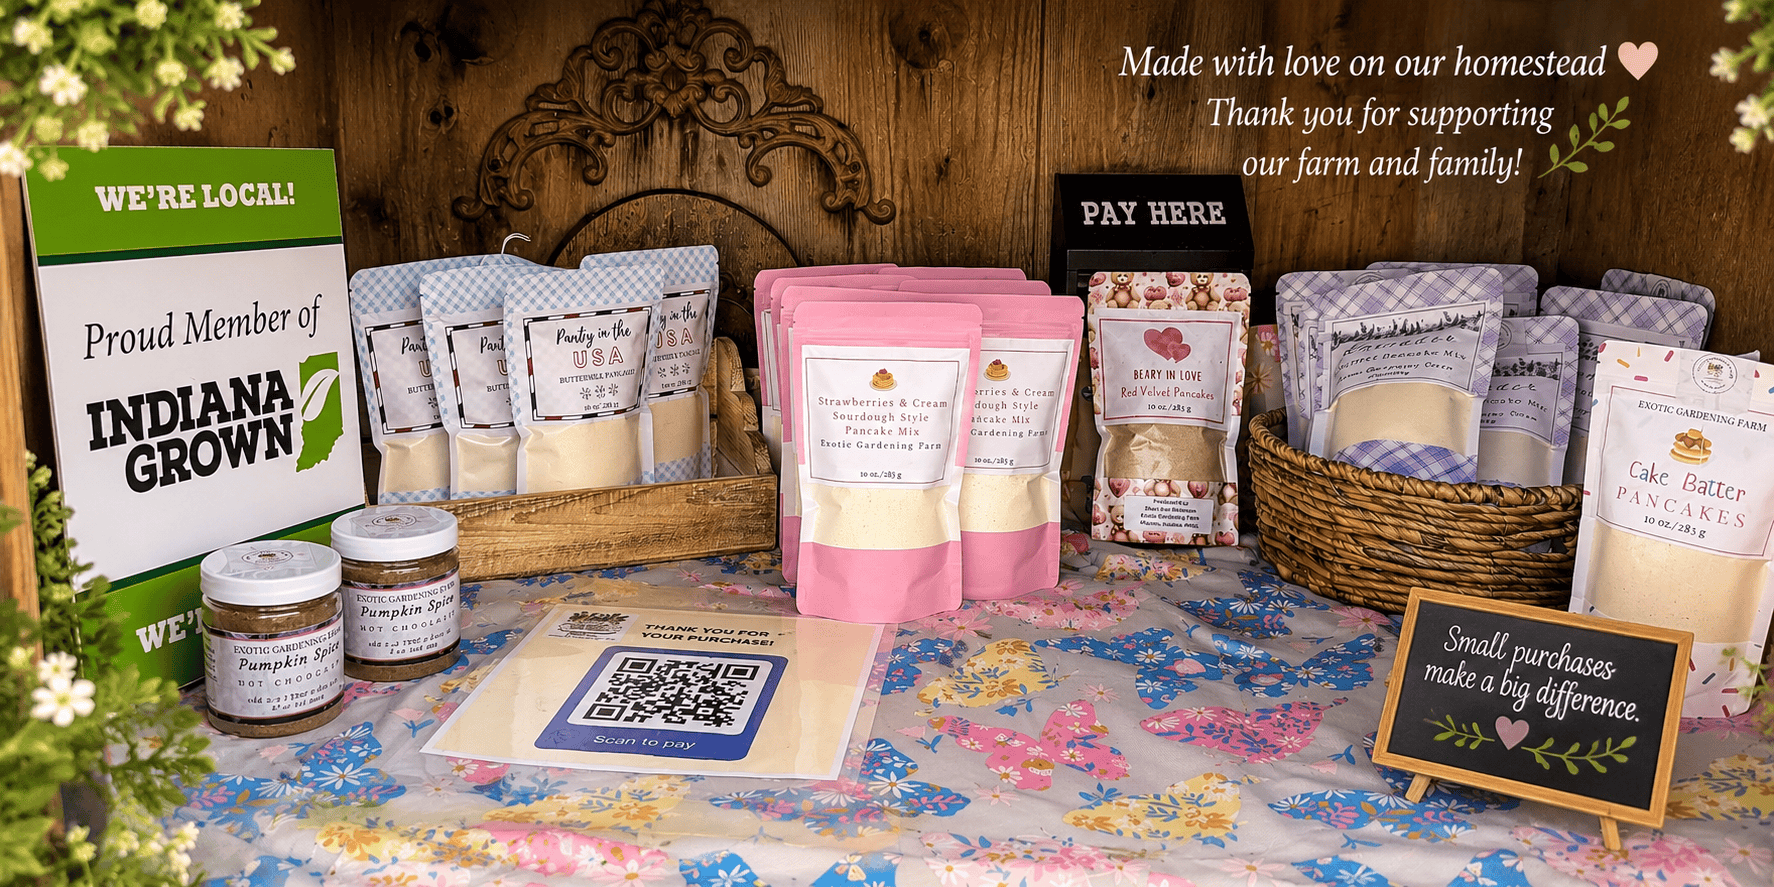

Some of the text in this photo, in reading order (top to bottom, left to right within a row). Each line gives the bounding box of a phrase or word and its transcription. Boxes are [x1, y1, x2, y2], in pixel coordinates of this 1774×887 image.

[95, 182, 295, 212] WE'RE LOCAL!
[1081, 201, 1227, 225] PAY HERE
[83, 294, 323, 361] Proud Member of
[597, 327, 610, 338] in
[611, 318, 632, 341] the
[572, 345, 624, 369] USA
[1133, 369, 1202, 381] BEARY IN LOVE
[1012, 388, 1019, 396] &
[1024, 388, 1055, 397] Cream
[1121, 386, 1138, 399] Red
[1174, 387, 1214, 400] Pancakes
[86, 369, 294, 451] INDIANA
[818, 396, 948, 408] Strawberries & Cream
[974, 400, 1039, 412] dough Style
[832, 411, 929, 424] Sourdough Style
[971, 415, 1007, 424] ancake
[1638, 400, 1767, 432] EXOTIC GARDENING FARM
[845, 426, 920, 436] Pancake Mix
[970, 428, 1024, 438] Gardening
[125, 412, 294, 493] GROWN
[820, 439, 852, 449] Exotic
[856, 441, 914, 451] Gardening
[1009, 458, 1014, 466] g
[1629, 461, 1746, 502] Cake Batter
[1616, 486, 1746, 528] PANCAKES
[1644, 515, 1656, 524] 10
[1698, 529, 1707, 539] g
[357, 588, 438, 603] EXOTIC GARDENING
[360, 604, 422, 621] Pumpkin
[135, 607, 203, 653] WE'
[645, 624, 770, 638] THANK YOU FOR
[641, 632, 775, 647] YOUR PURCHASE!
[233, 645, 270, 655] EXOTIC
[1443, 625, 1615, 680] Small purchases
[238, 654, 308, 674] Pumpkin
[1423, 660, 1640, 723] make a big difference.
[593, 735, 696, 751] Scan to pay
